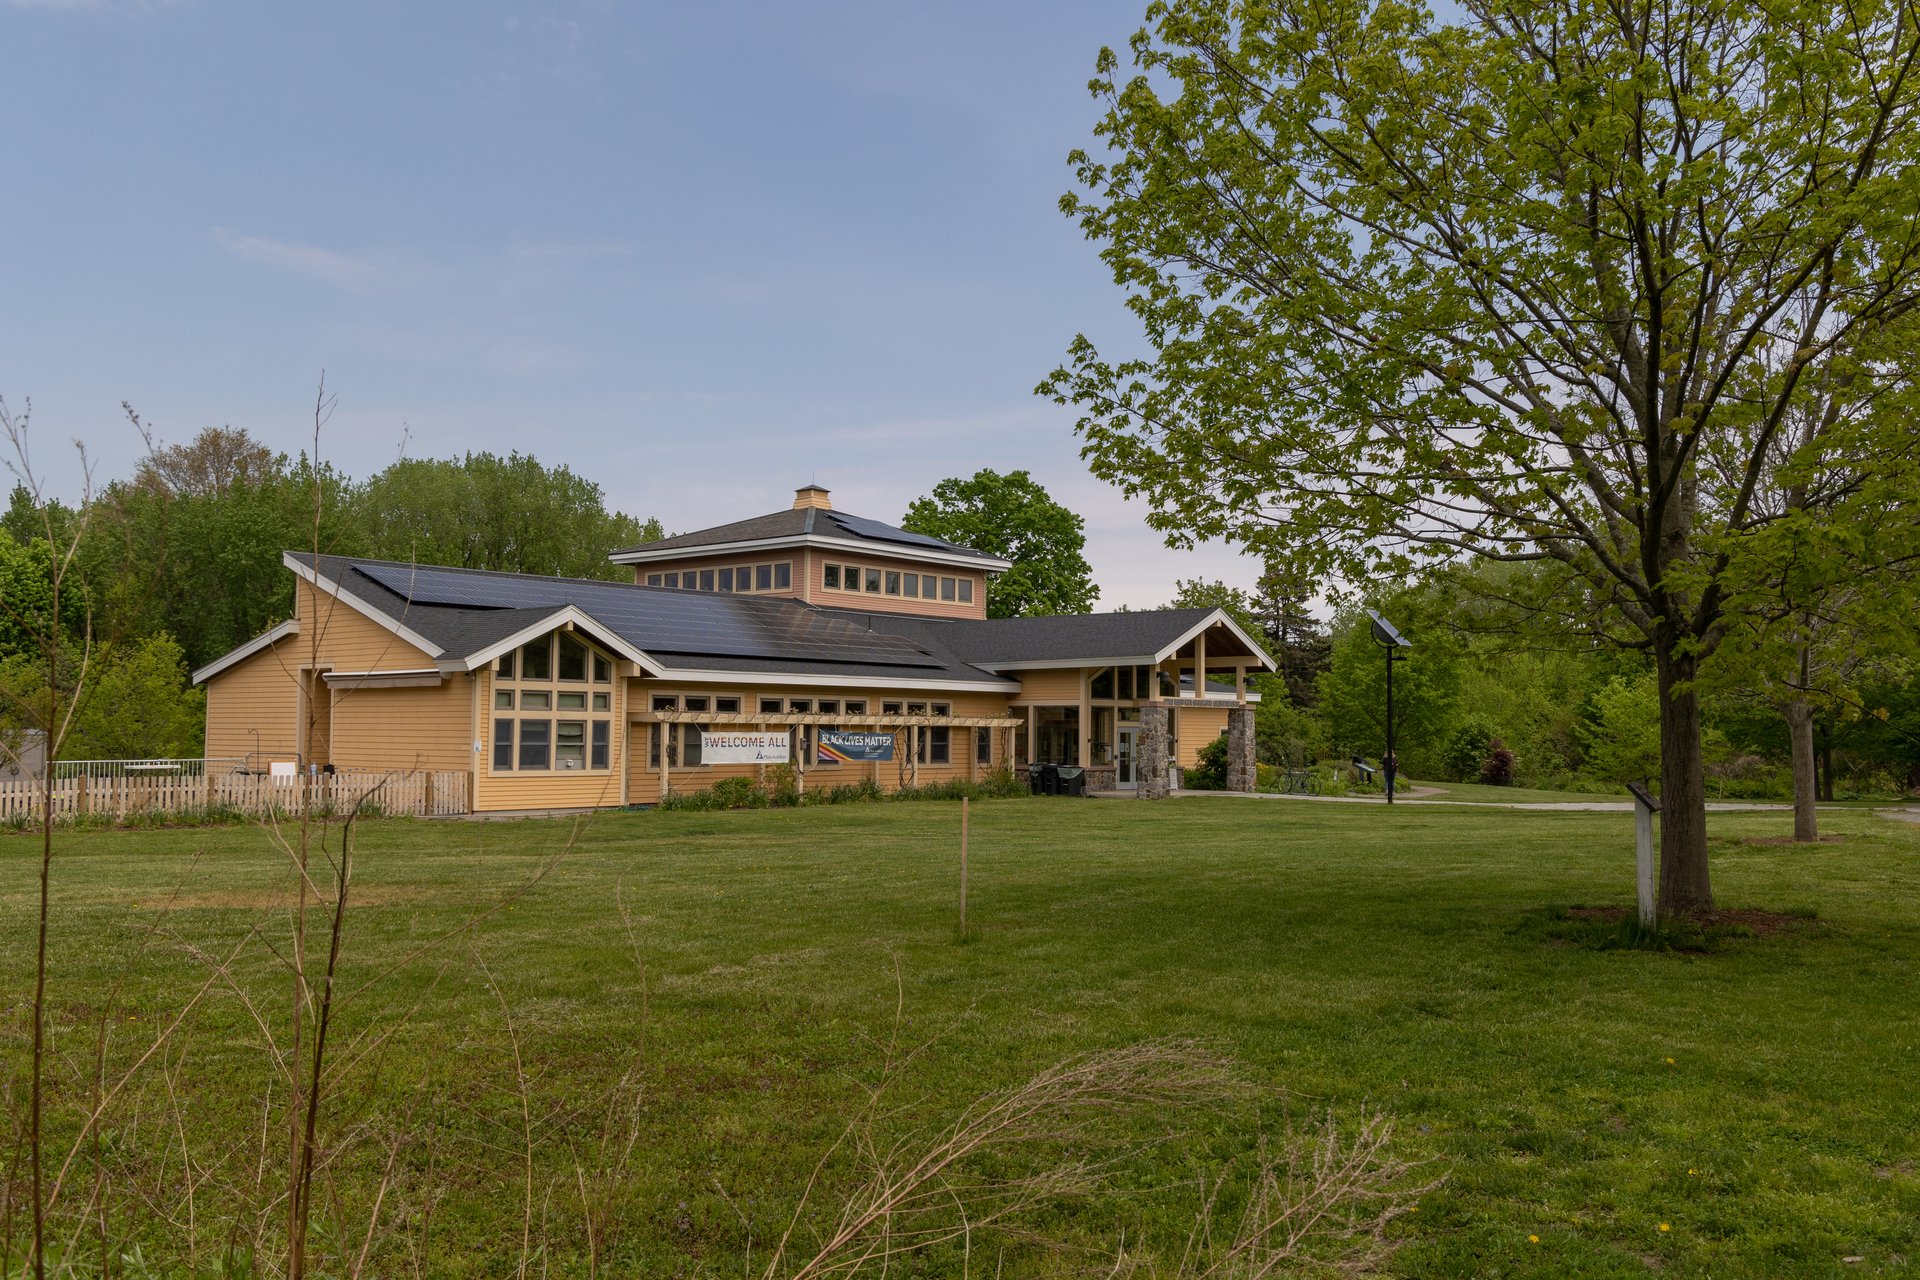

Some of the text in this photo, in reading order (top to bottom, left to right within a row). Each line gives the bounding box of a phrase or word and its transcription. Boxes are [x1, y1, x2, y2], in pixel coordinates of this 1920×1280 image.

[709, 736, 764, 747] WELCOME
[768, 736, 786, 747] ALL
[822, 733, 891, 746] BLACK LIVES MATTER
